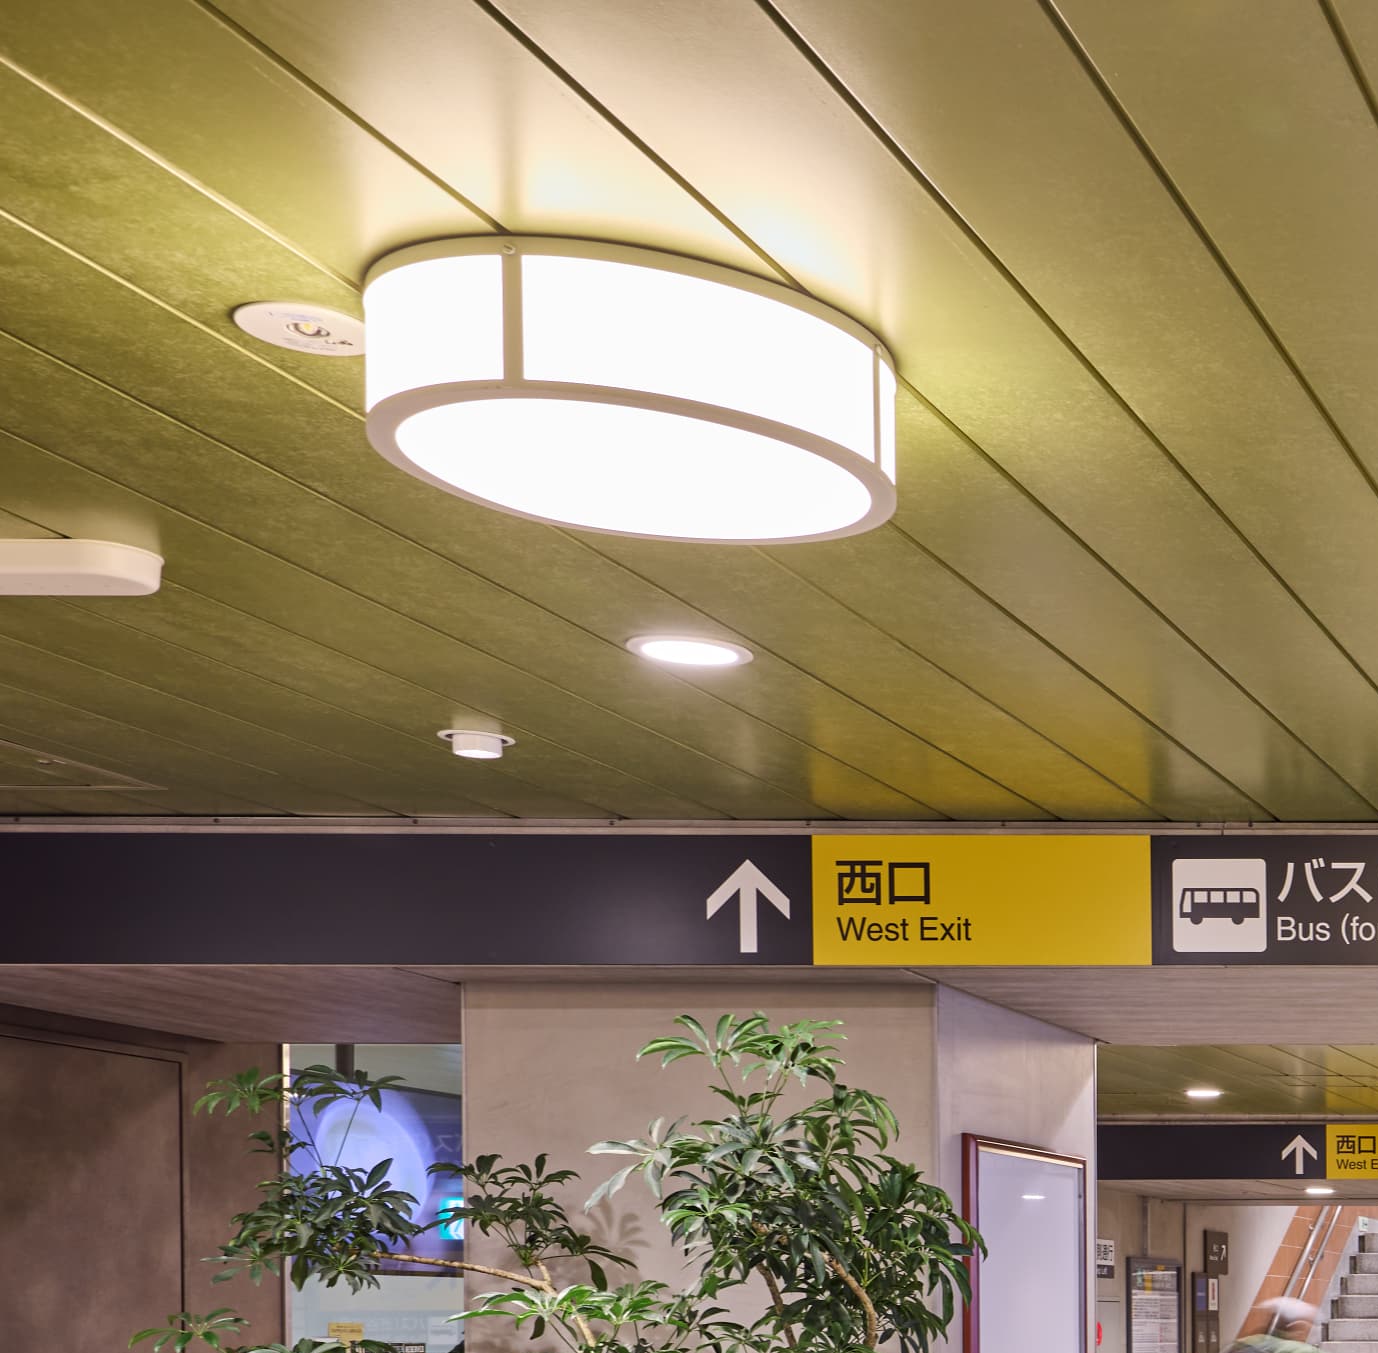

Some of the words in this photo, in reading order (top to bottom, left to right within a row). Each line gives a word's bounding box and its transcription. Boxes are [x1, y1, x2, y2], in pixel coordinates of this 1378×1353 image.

[835, 860, 931, 906] 西口
[836, 916, 910, 942] West
[919, 916, 972, 942] Exit
[1277, 916, 1331, 942] Bus
[1335, 1134, 1377, 1155] 西口
[1335, 1158, 1368, 1170] West
